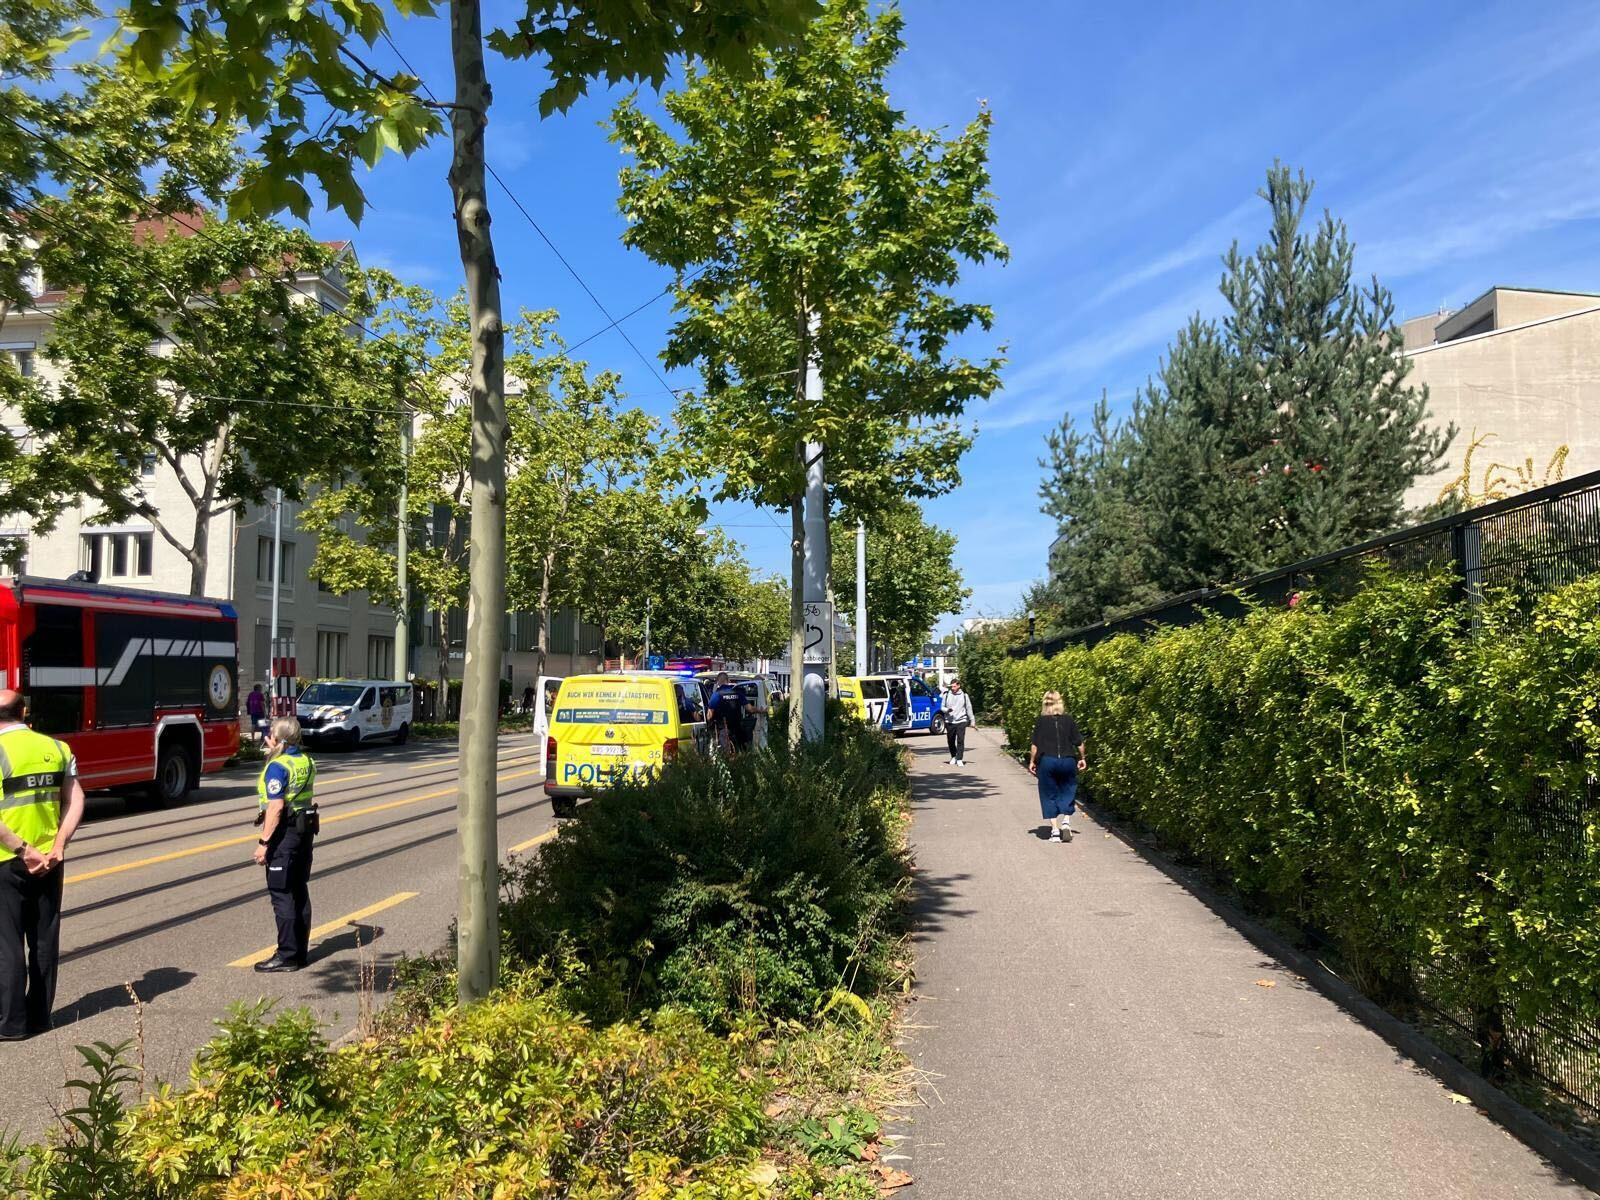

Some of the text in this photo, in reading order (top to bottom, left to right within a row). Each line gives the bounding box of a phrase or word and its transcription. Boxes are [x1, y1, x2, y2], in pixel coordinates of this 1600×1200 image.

[866, 701, 884, 724] 17
[648, 750, 661, 759] 35
[26, 774, 54, 787] BVB
